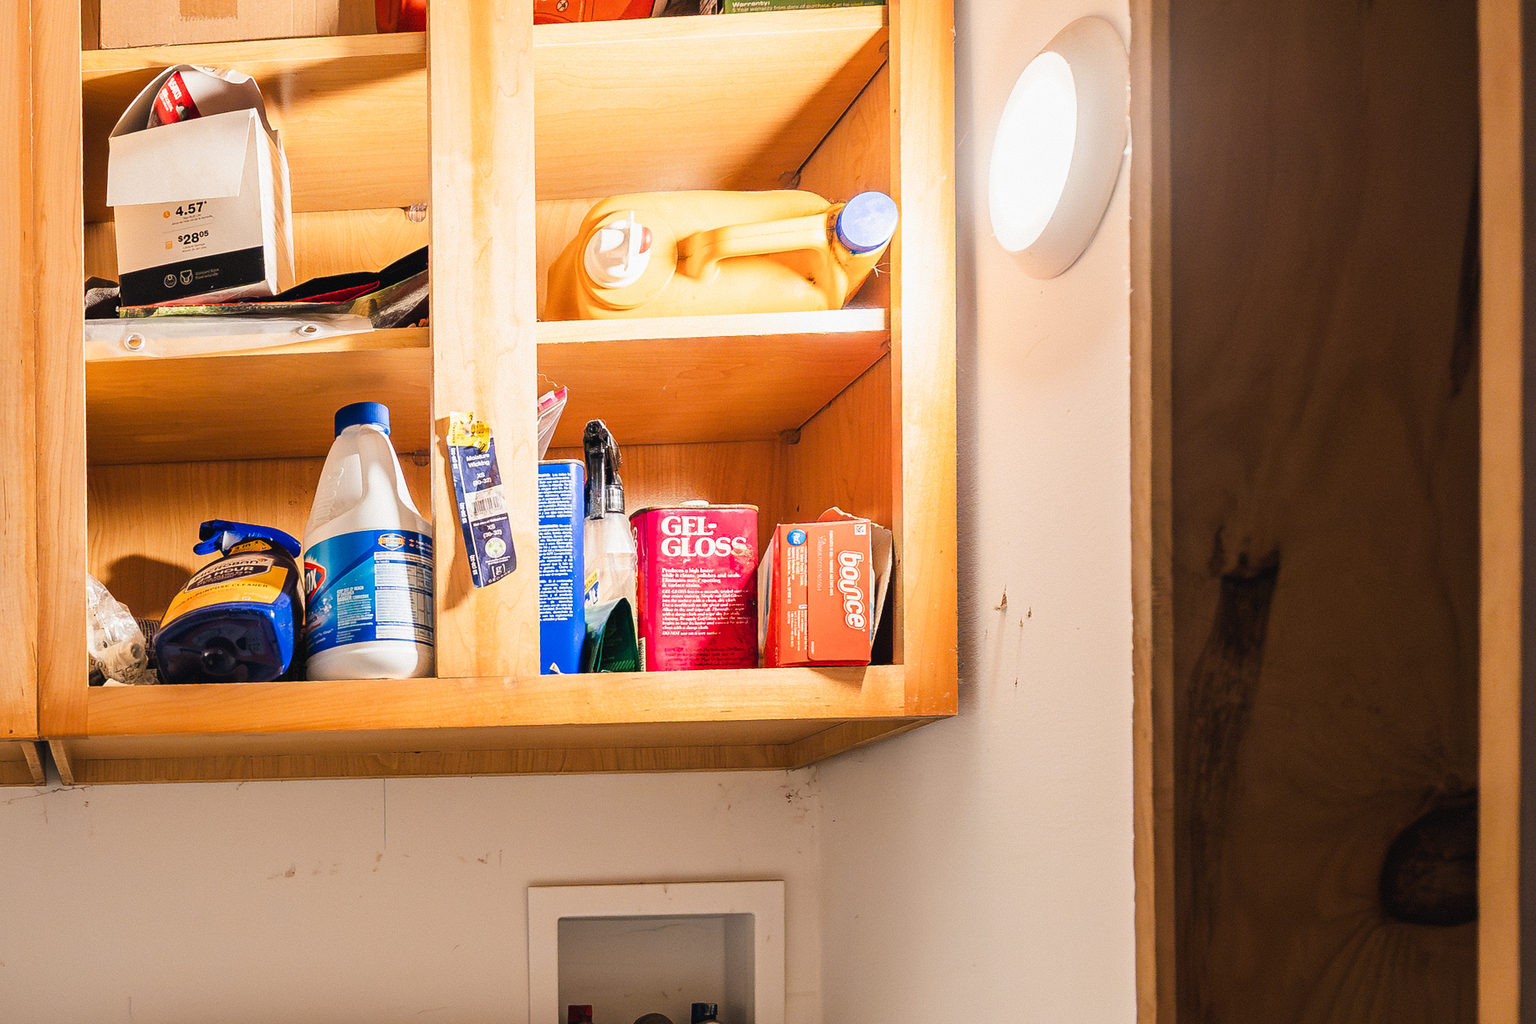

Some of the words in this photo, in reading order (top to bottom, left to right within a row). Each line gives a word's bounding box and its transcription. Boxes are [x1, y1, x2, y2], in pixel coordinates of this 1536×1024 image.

[660, 515, 718, 536] GEL-
[660, 536, 747, 557] GLOSS
[839, 550, 866, 629] bounce
